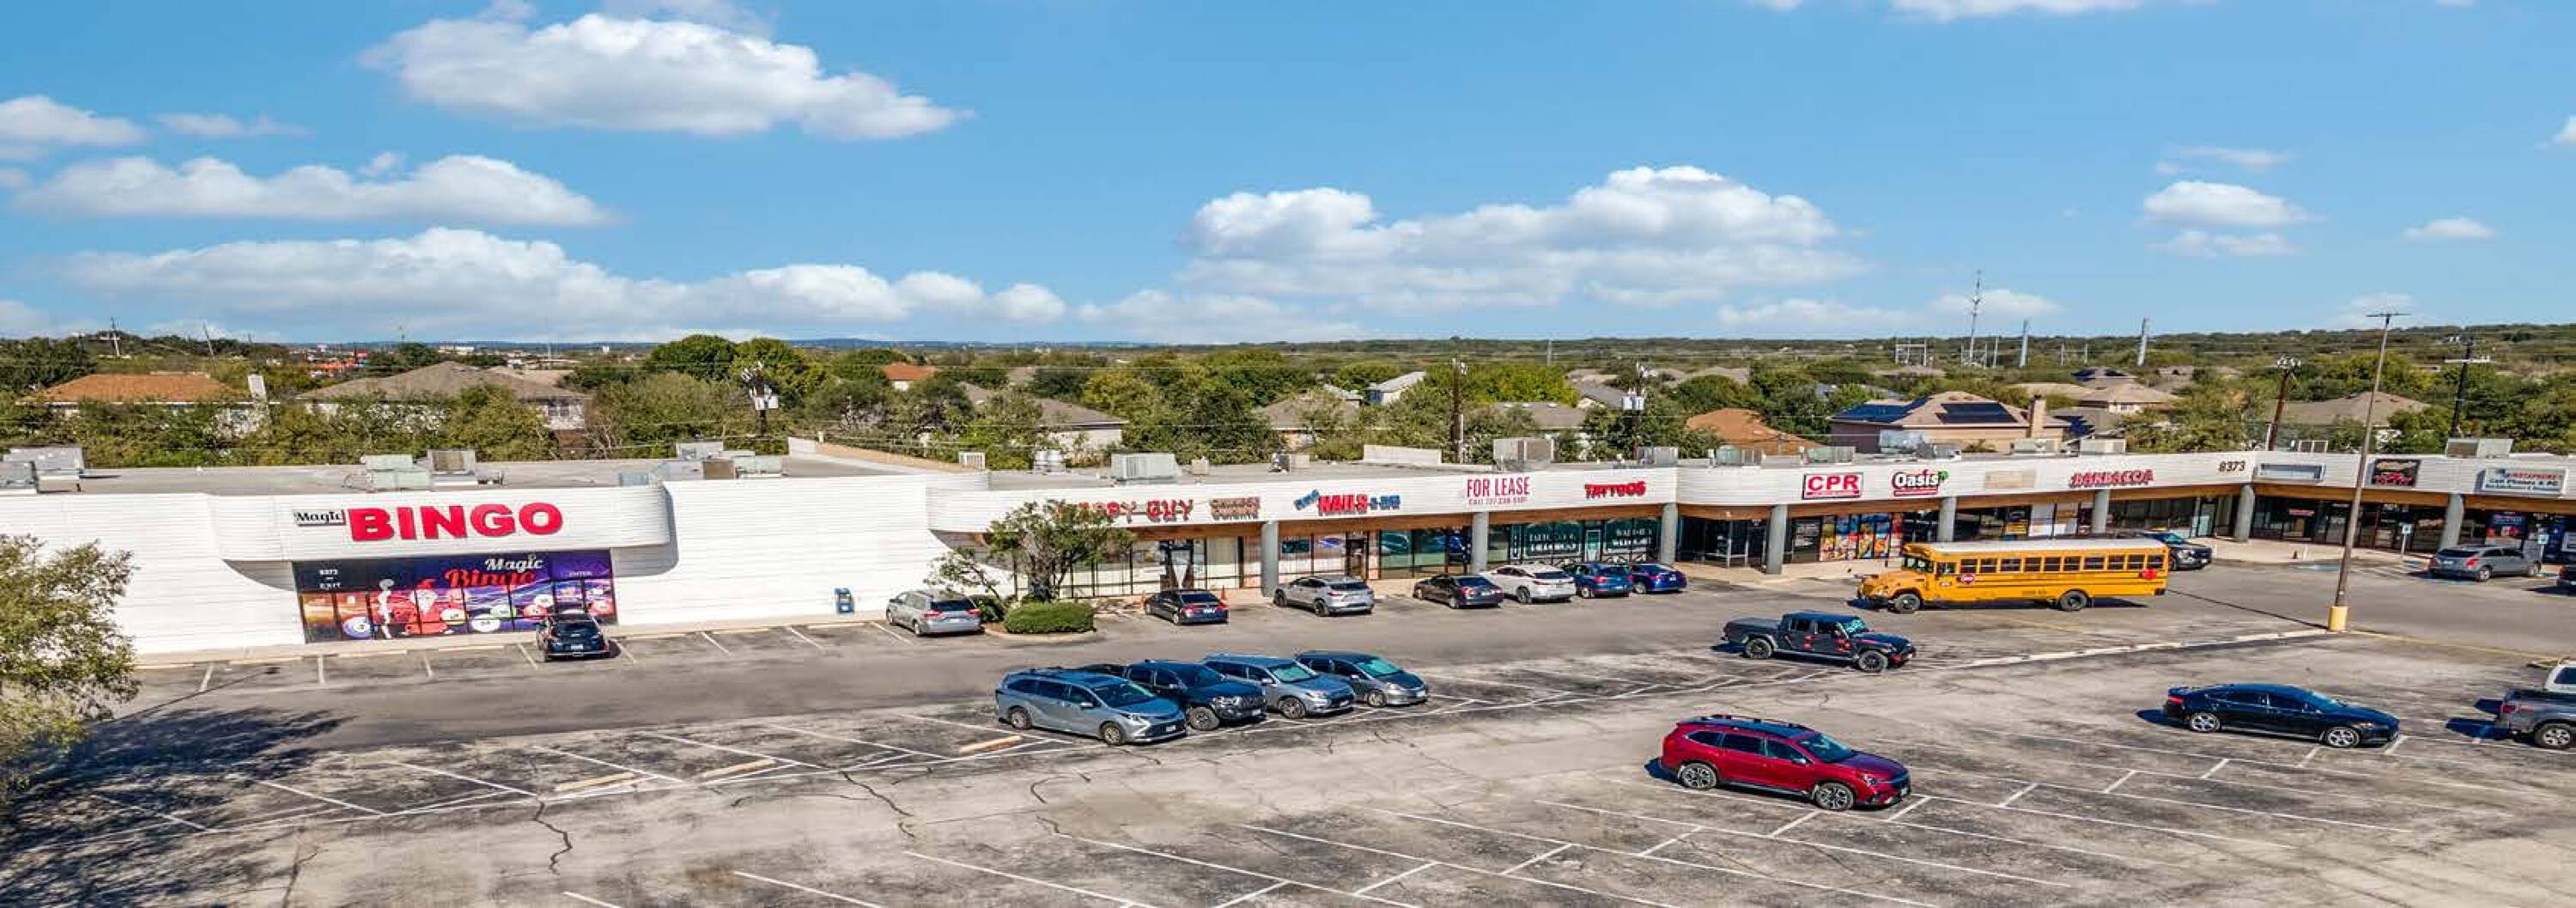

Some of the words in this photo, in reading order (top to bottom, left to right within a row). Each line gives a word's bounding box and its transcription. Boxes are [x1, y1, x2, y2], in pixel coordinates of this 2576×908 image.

[2218, 460, 2245, 472] 8373
[1467, 478, 1491, 497] FOR
[1495, 477, 1530, 496] LEASE
[1807, 474, 1859, 491] CPR
[1893, 470, 1939, 488] Oasis
[1146, 499, 1194, 521] GUY
[1318, 494, 1369, 515] NAILS
[295, 510, 342, 523] Magic
[348, 502, 563, 541] BINGO
[485, 554, 544, 573] Magic
[444, 567, 537, 588] Bingo
